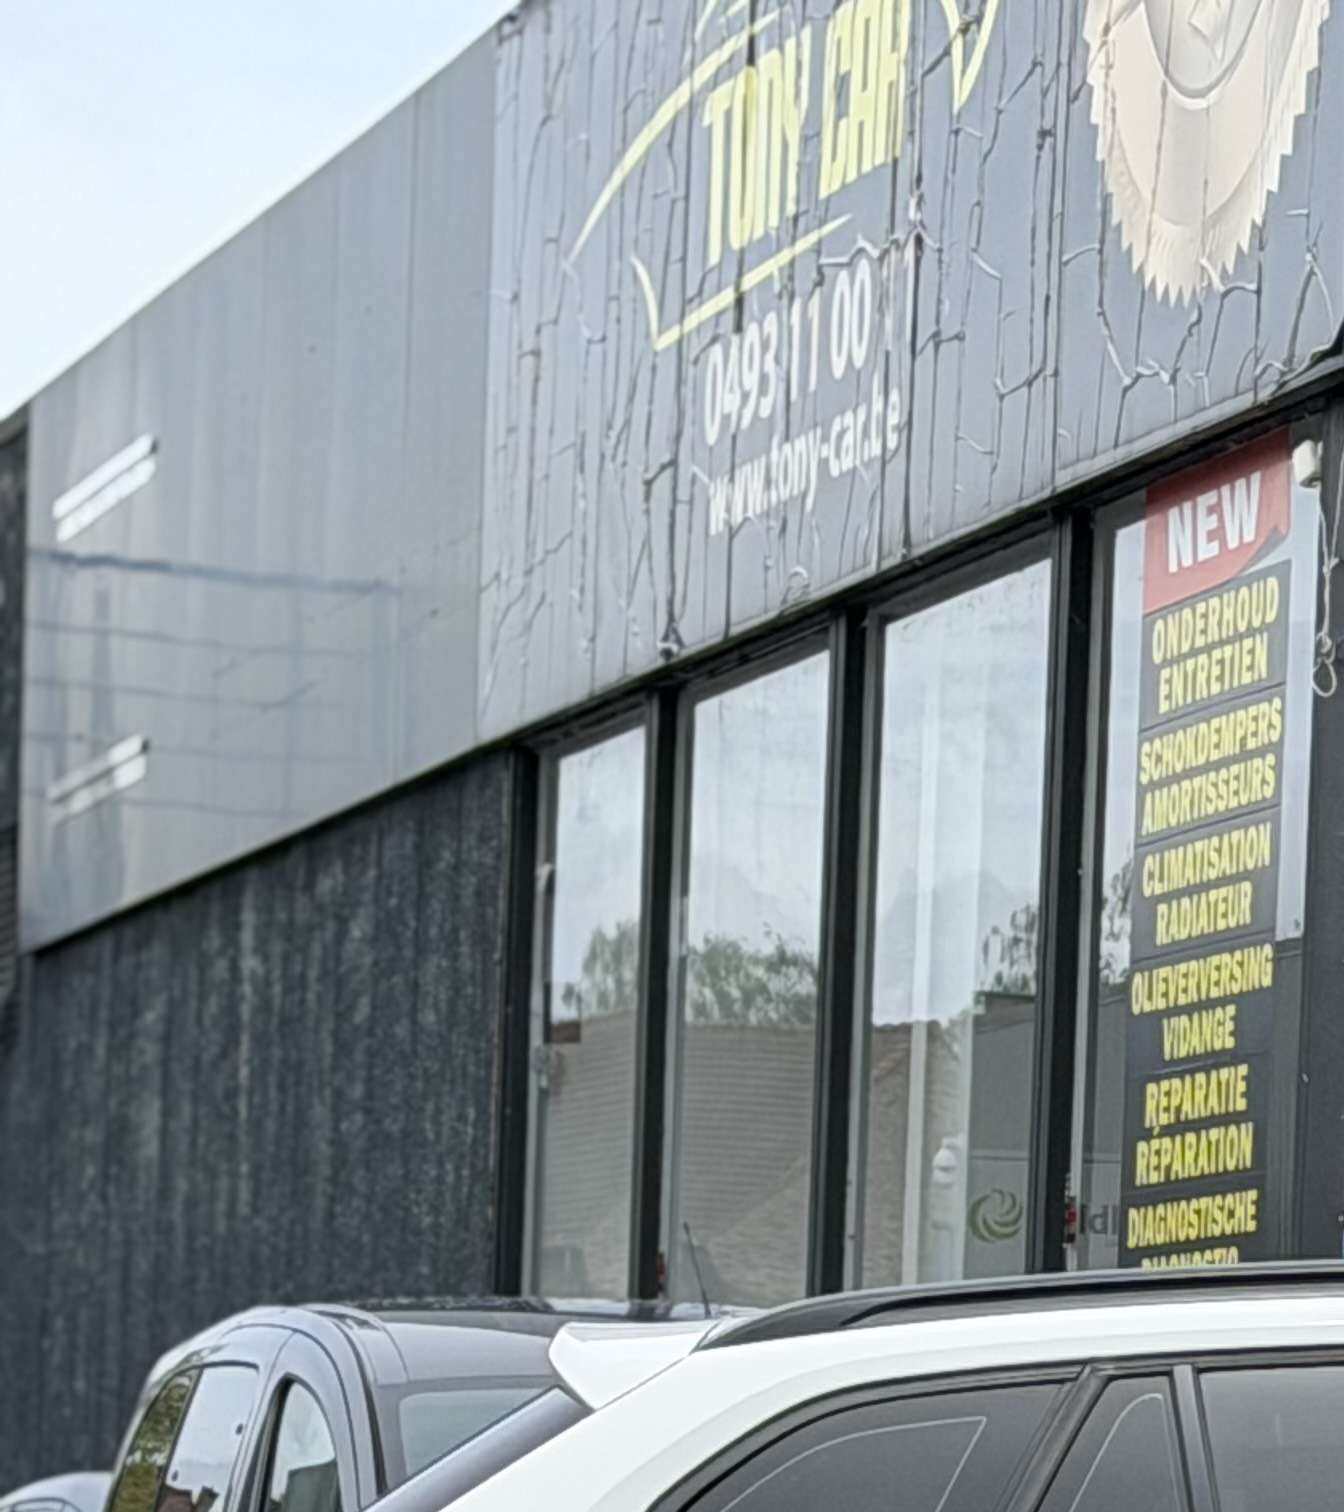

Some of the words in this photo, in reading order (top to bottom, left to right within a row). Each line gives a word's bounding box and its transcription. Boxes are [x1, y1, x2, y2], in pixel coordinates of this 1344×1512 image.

[702, 27, 812, 267] TONY
[705, 311, 777, 447] 0493
[830, 258, 872, 381] 00
[708, 372, 900, 536] www.tony-car.be
[1167, 471, 1263, 573] NEW
[1152, 576, 1280, 665] ONDERHOUD
[1158, 632, 1269, 714] ENTRETIEN
[1140, 696, 1283, 785] SCHOKDEMPERS
[1141, 753, 1276, 836] AMORTISSEURS
[1142, 821, 1271, 898] CLIMATISATION
[1156, 880, 1253, 947] RADIATEUR
[1131, 943, 1273, 1016] OLIEVERVERSING
[1162, 1004, 1237, 1061] VIDANGE
[1144, 1063, 1249, 1128] REPARATIE
[1135, 1122, 1254, 1187] RÉPARATION
[1126, 1189, 1258, 1249] DIAGNOSTISCHE
